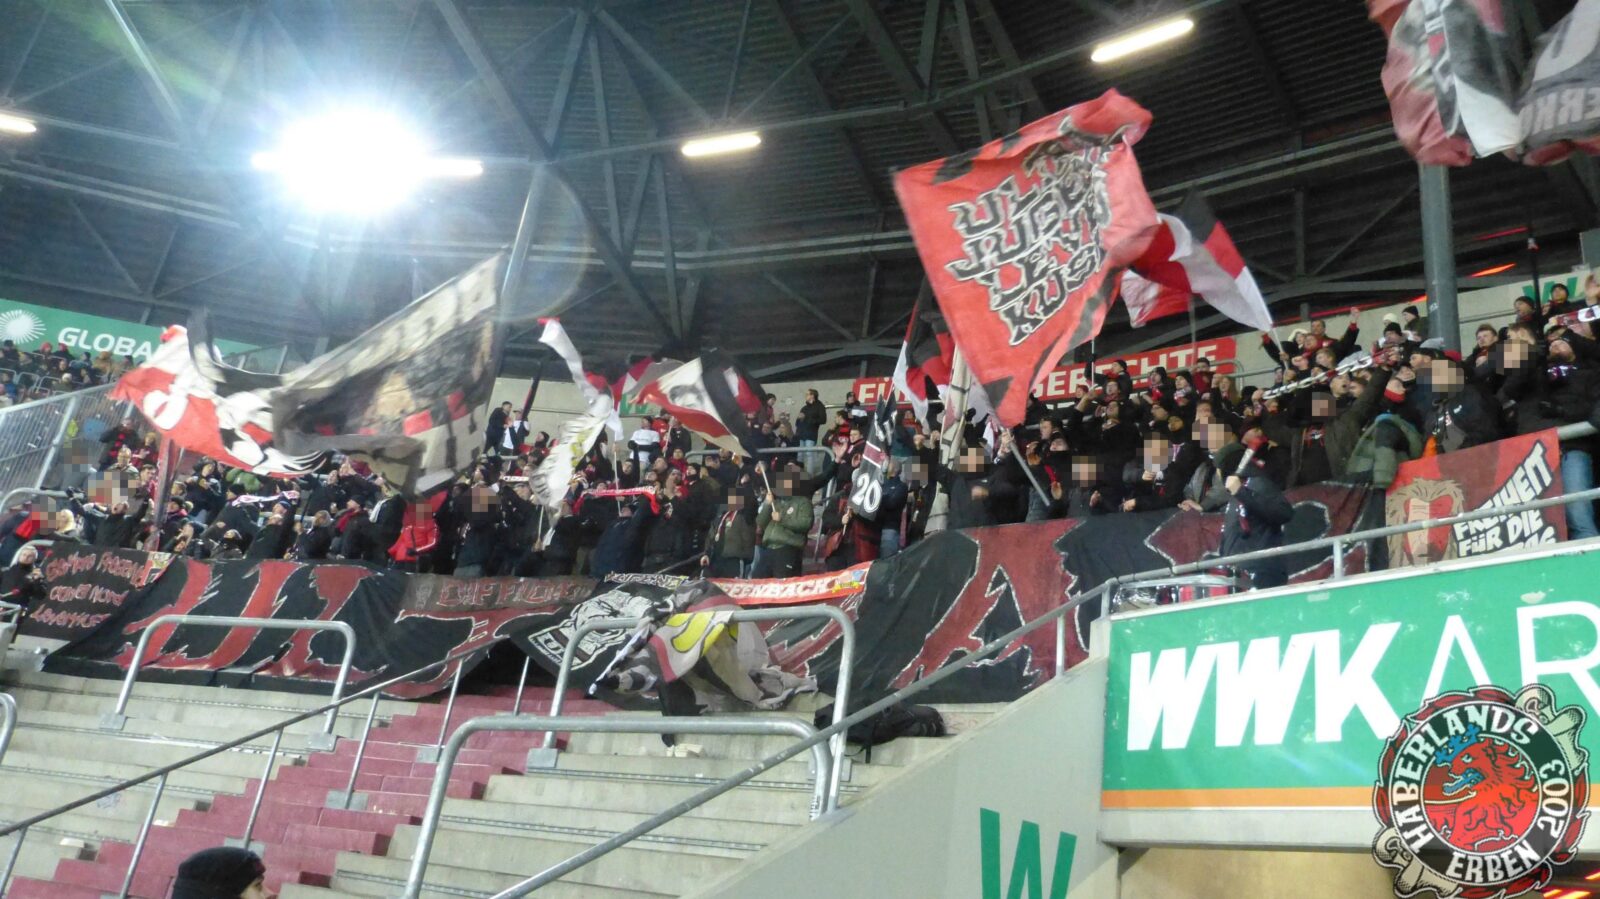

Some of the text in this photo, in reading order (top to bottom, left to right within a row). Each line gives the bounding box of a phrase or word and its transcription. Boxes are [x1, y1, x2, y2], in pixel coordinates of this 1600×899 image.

[58, 326, 161, 358] GLOBA
[852, 472, 883, 513] 20
[1458, 525, 1503, 558] FÜR
[1507, 509, 1543, 545] DIE
[1127, 622, 1401, 751] WWK
